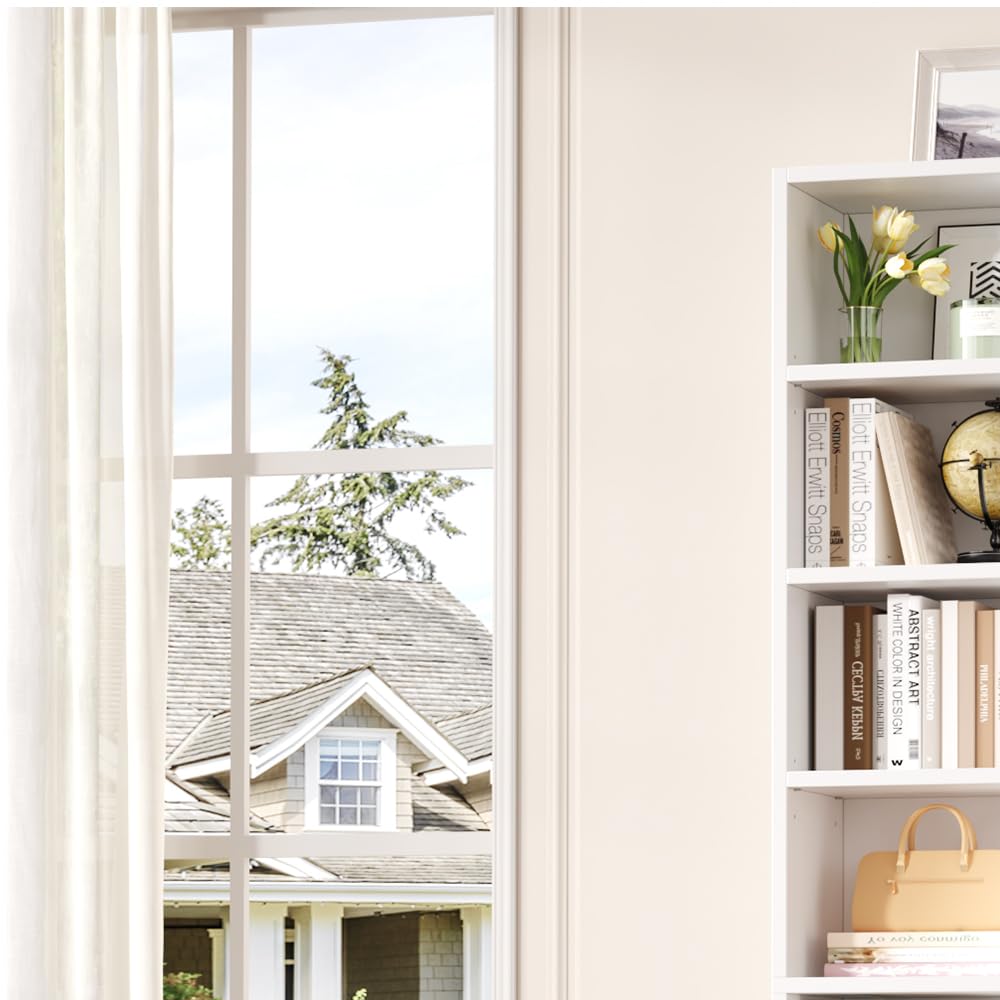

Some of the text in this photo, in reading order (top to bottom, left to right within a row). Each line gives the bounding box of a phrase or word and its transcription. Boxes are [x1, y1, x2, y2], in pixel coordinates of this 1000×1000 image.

[806, 412, 827, 554] Elliott Erwitt Snaps
[831, 411, 845, 455] Cosmos
[850, 402, 872, 553] Elliott Erwitt Snaps
[892, 602, 903, 736] WHITE COLOR IN DESIGN
[908, 609, 920, 705] ABSTRACT ART
[925, 615, 937, 721] wright architecture
